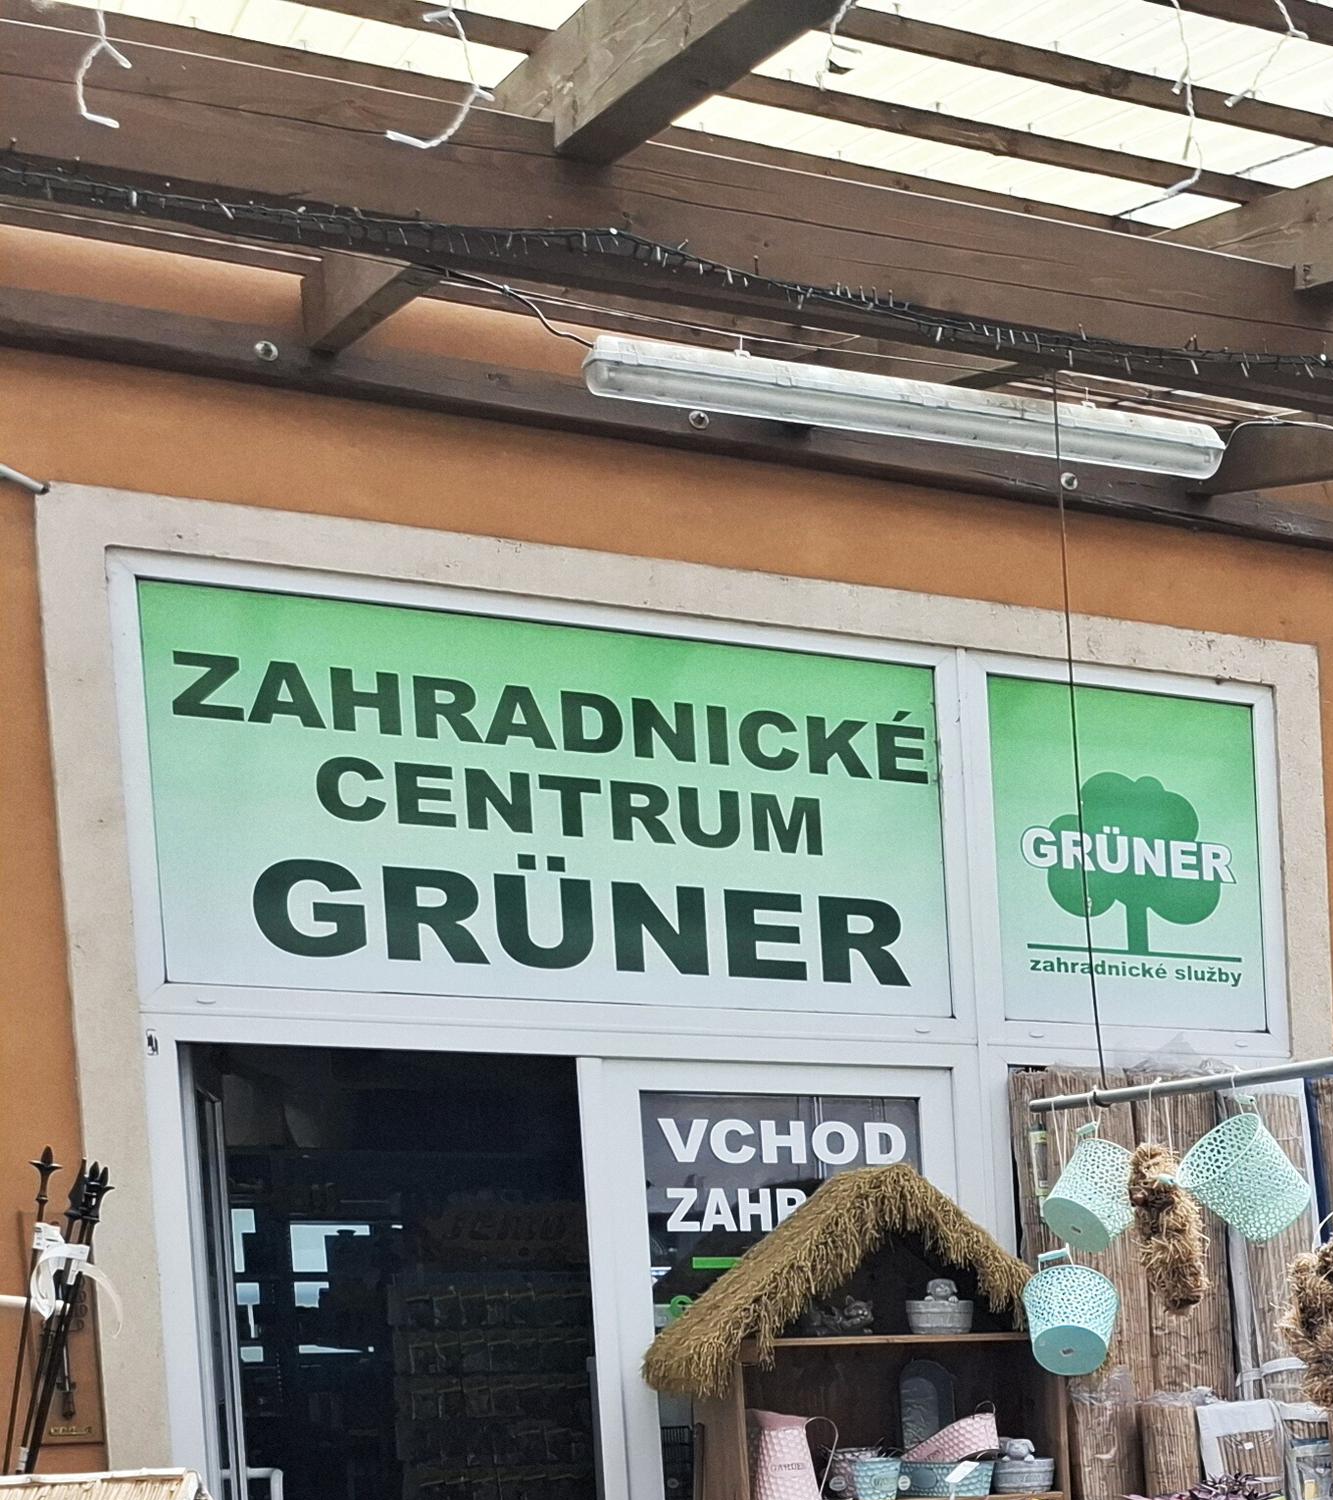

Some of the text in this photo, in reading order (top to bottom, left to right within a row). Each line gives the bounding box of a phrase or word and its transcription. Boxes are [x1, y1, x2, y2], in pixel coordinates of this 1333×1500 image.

[172, 650, 930, 785] ZAHRADNICKÉ
[315, 756, 824, 856] CENTRUM
[1021, 825, 1236, 884] GRÜNER
[252, 853, 912, 988] GRÜNER
[1029, 957, 1242, 987] zahradnické služby
[657, 1118, 907, 1165] VCHOD
